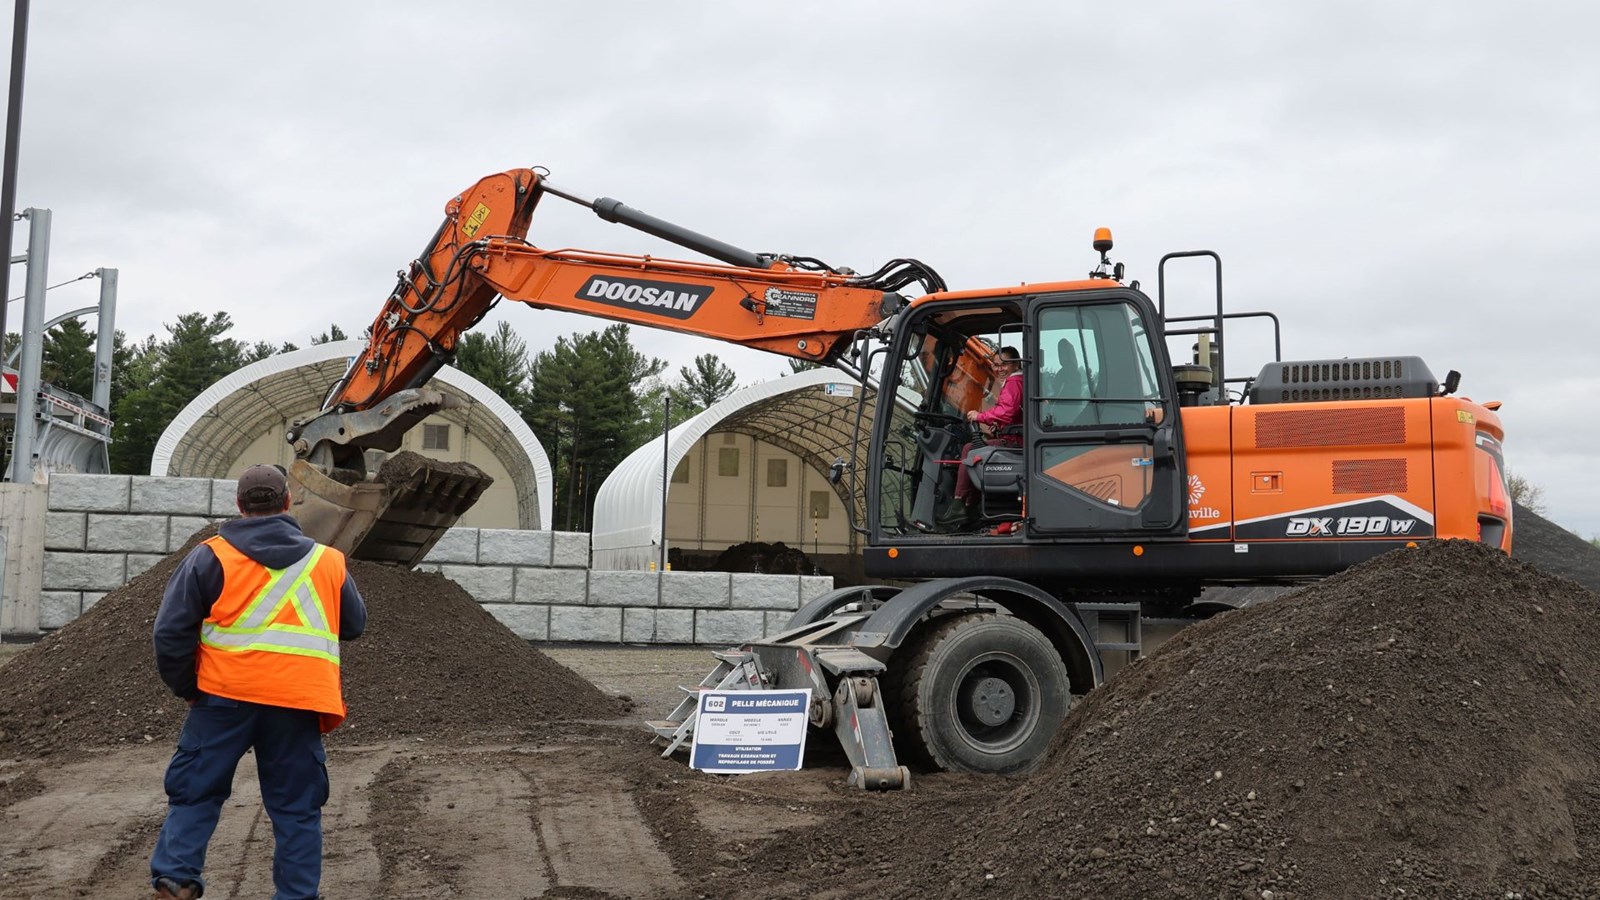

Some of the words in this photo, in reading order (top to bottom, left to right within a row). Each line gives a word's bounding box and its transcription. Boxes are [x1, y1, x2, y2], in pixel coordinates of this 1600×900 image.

[586, 279, 699, 312] DOOSAN
[1286, 517, 1333, 536] DX
[1336, 516, 1390, 535] 190
[708, 700, 724, 708] 602
[755, 699, 799, 707] MÉCANIQUE
